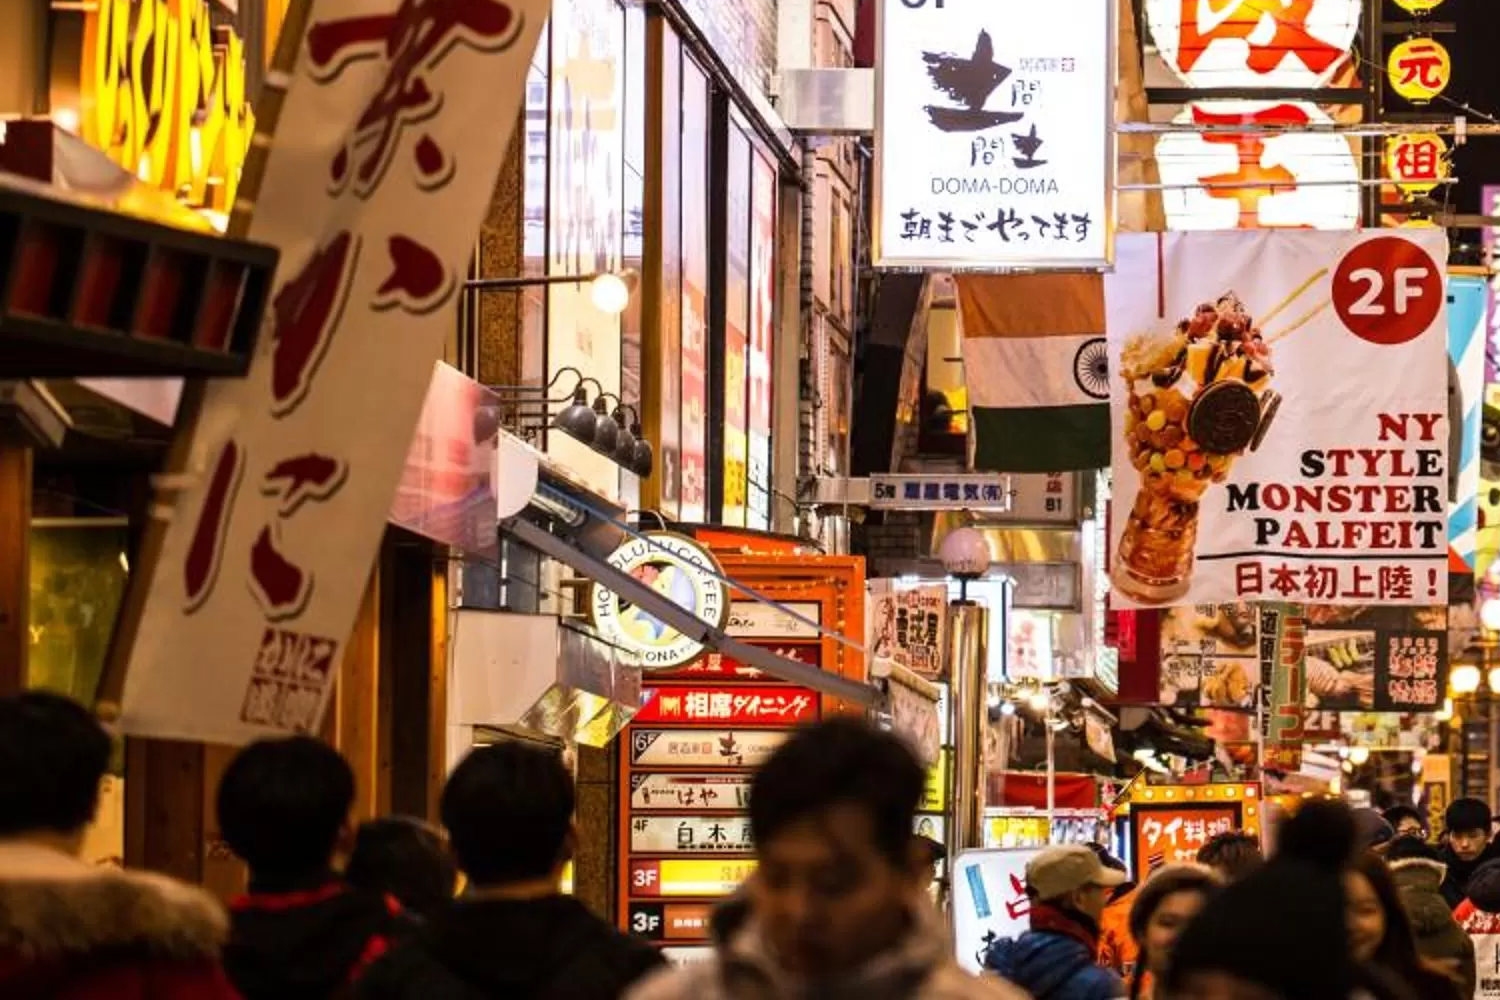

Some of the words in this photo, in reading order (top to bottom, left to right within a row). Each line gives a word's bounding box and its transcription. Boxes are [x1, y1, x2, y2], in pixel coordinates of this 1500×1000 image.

[931, 177, 1060, 196] DOMA-DOMA
[900, 207, 1093, 243] 朝までやってます
[1346, 265, 1430, 316] 2F
[1377, 413, 1443, 442] NY
[1299, 449, 1444, 478] STYLE
[1226, 483, 1444, 514] MONSTER
[1254, 520, 1444, 550] PALFEIT
[1233, 562, 1439, 600] 日本初上陸!
[684, 691, 811, 718] 相席ダイニング
[1304, 711, 1338, 731] 2F
[632, 819, 649, 832] 4F
[1142, 817, 1231, 847] タイ料理
[633, 869, 657, 887] 3F
[632, 912, 661, 932] 3F
